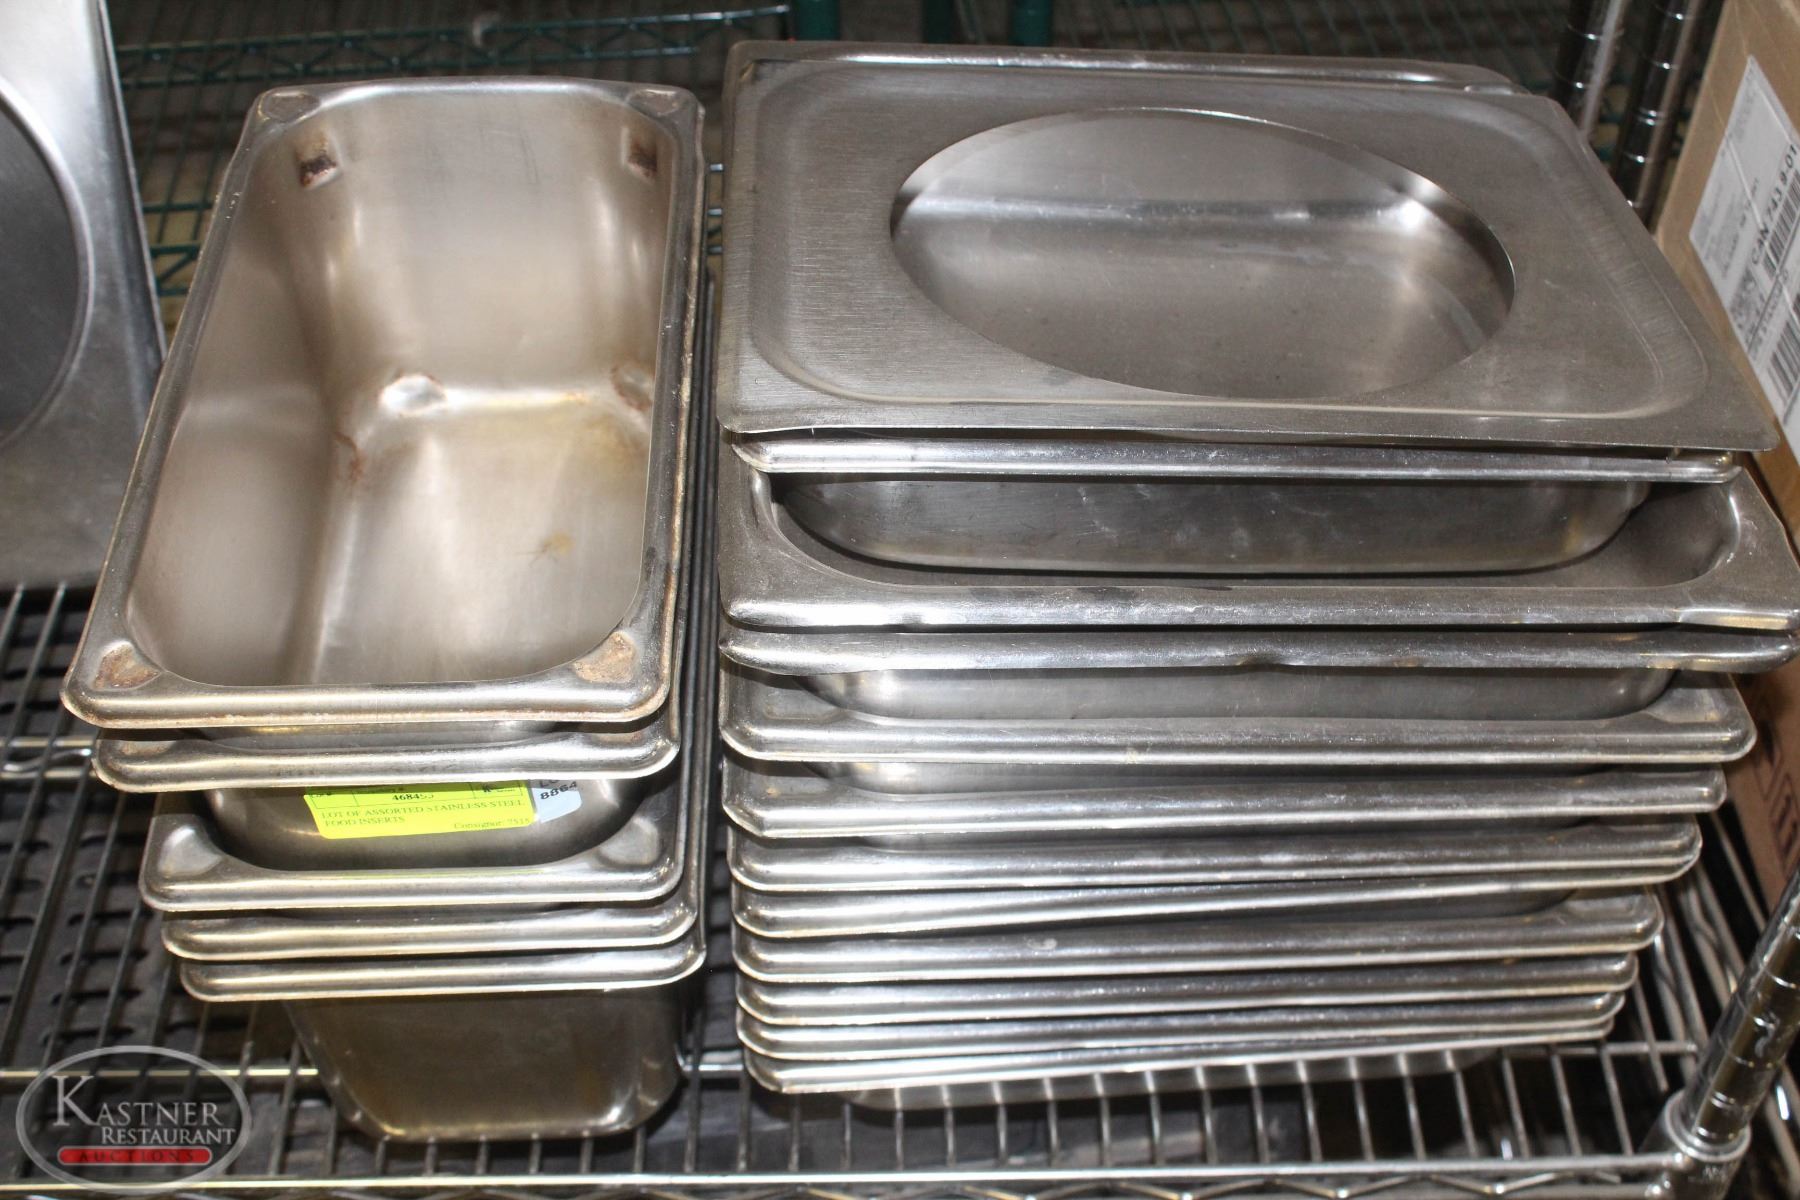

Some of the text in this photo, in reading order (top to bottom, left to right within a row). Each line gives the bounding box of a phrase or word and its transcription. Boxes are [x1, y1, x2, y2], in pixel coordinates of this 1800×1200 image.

[540, 781, 577, 800] 8864
[321, 811, 343, 819] LOT
[365, 807, 424, 816] ASSORTED
[324, 816, 405, 827] FOOD INSERTS
